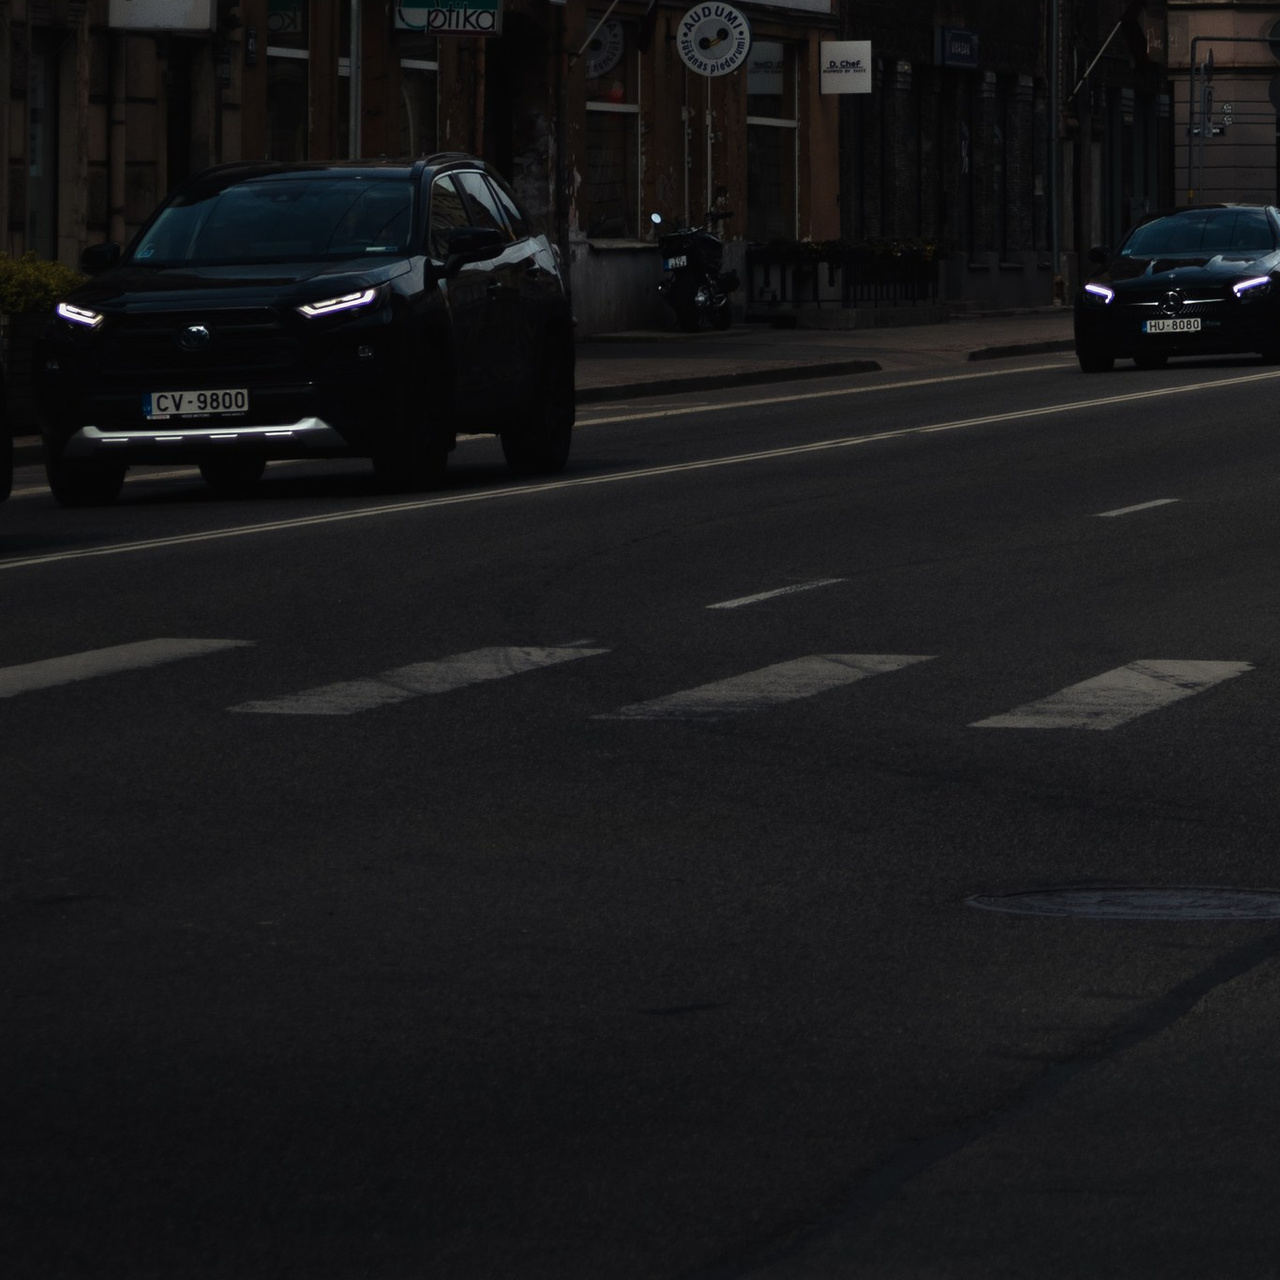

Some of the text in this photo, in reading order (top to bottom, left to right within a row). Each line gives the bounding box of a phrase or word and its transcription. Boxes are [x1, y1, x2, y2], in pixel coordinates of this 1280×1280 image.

[684, 6, 742, 33] AUDUMI
[681, 37, 746, 75] šūšanas piederumi
[1149, 319, 1200, 332] HU-8080
[156, 391, 245, 412] CV-9800
